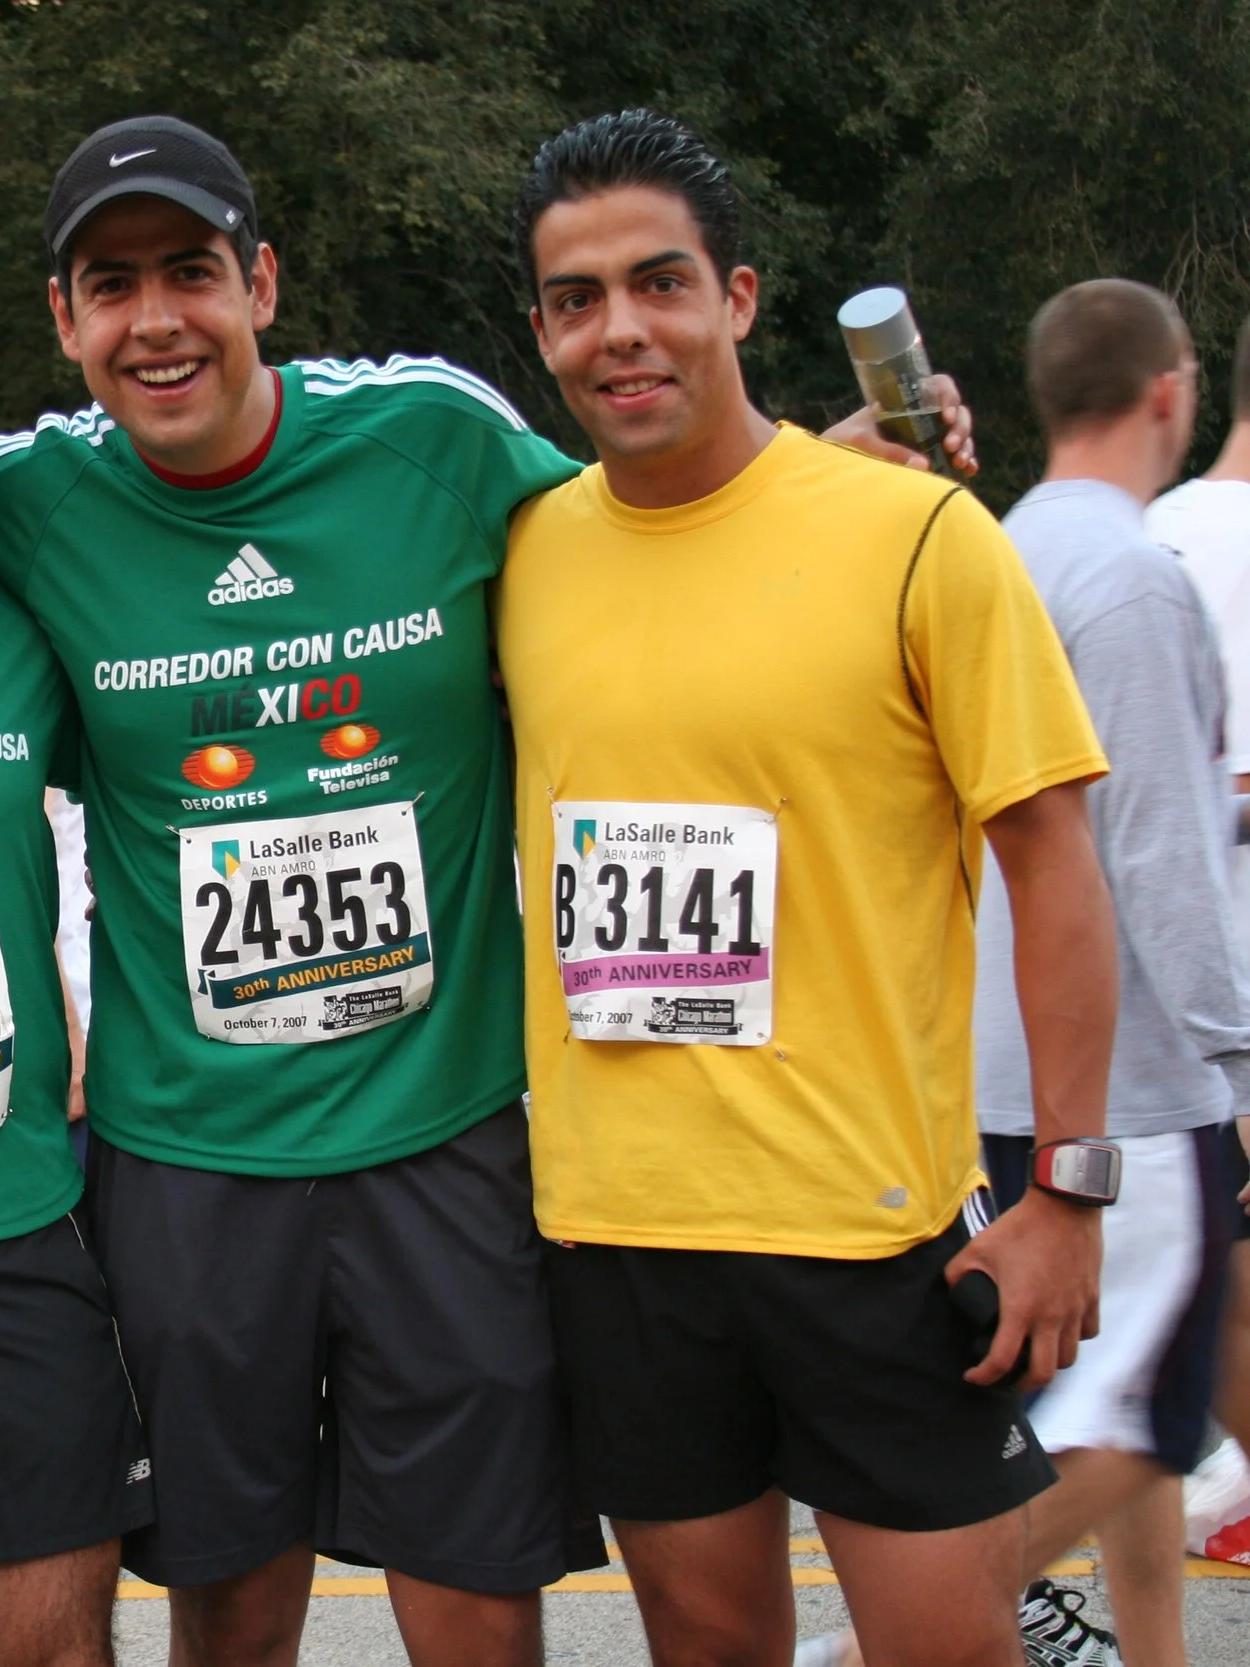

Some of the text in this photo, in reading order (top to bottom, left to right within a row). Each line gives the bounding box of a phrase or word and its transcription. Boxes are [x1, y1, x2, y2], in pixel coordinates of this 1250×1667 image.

[207, 576, 294, 606] adidas
[94, 608, 443, 690] CORREDOR CON CAUSA
[191, 673, 362, 737] MÉXICO
[307, 753, 398, 782] Fundación
[319, 770, 390, 795] Televisa
[181, 790, 268, 811] DEPORTES
[250, 826, 379, 859] LaSalle Bank
[605, 822, 735, 845] LaSalle Bank
[251, 860, 316, 877] ABN AMRO
[603, 849, 666, 862] ABN AMRO
[196, 861, 412, 967] 24353
[233, 946, 415, 1001] 30th ANNIVERSARY
[573, 959, 753, 987] 30th ANNIVERSARY
[224, 1016, 308, 1030] October 7, 2007
[595, 1012, 604, 1024] 7,
[607, 1012, 633, 1024] 2007
[674, 1026, 729, 1034] ANNIVERSARY
